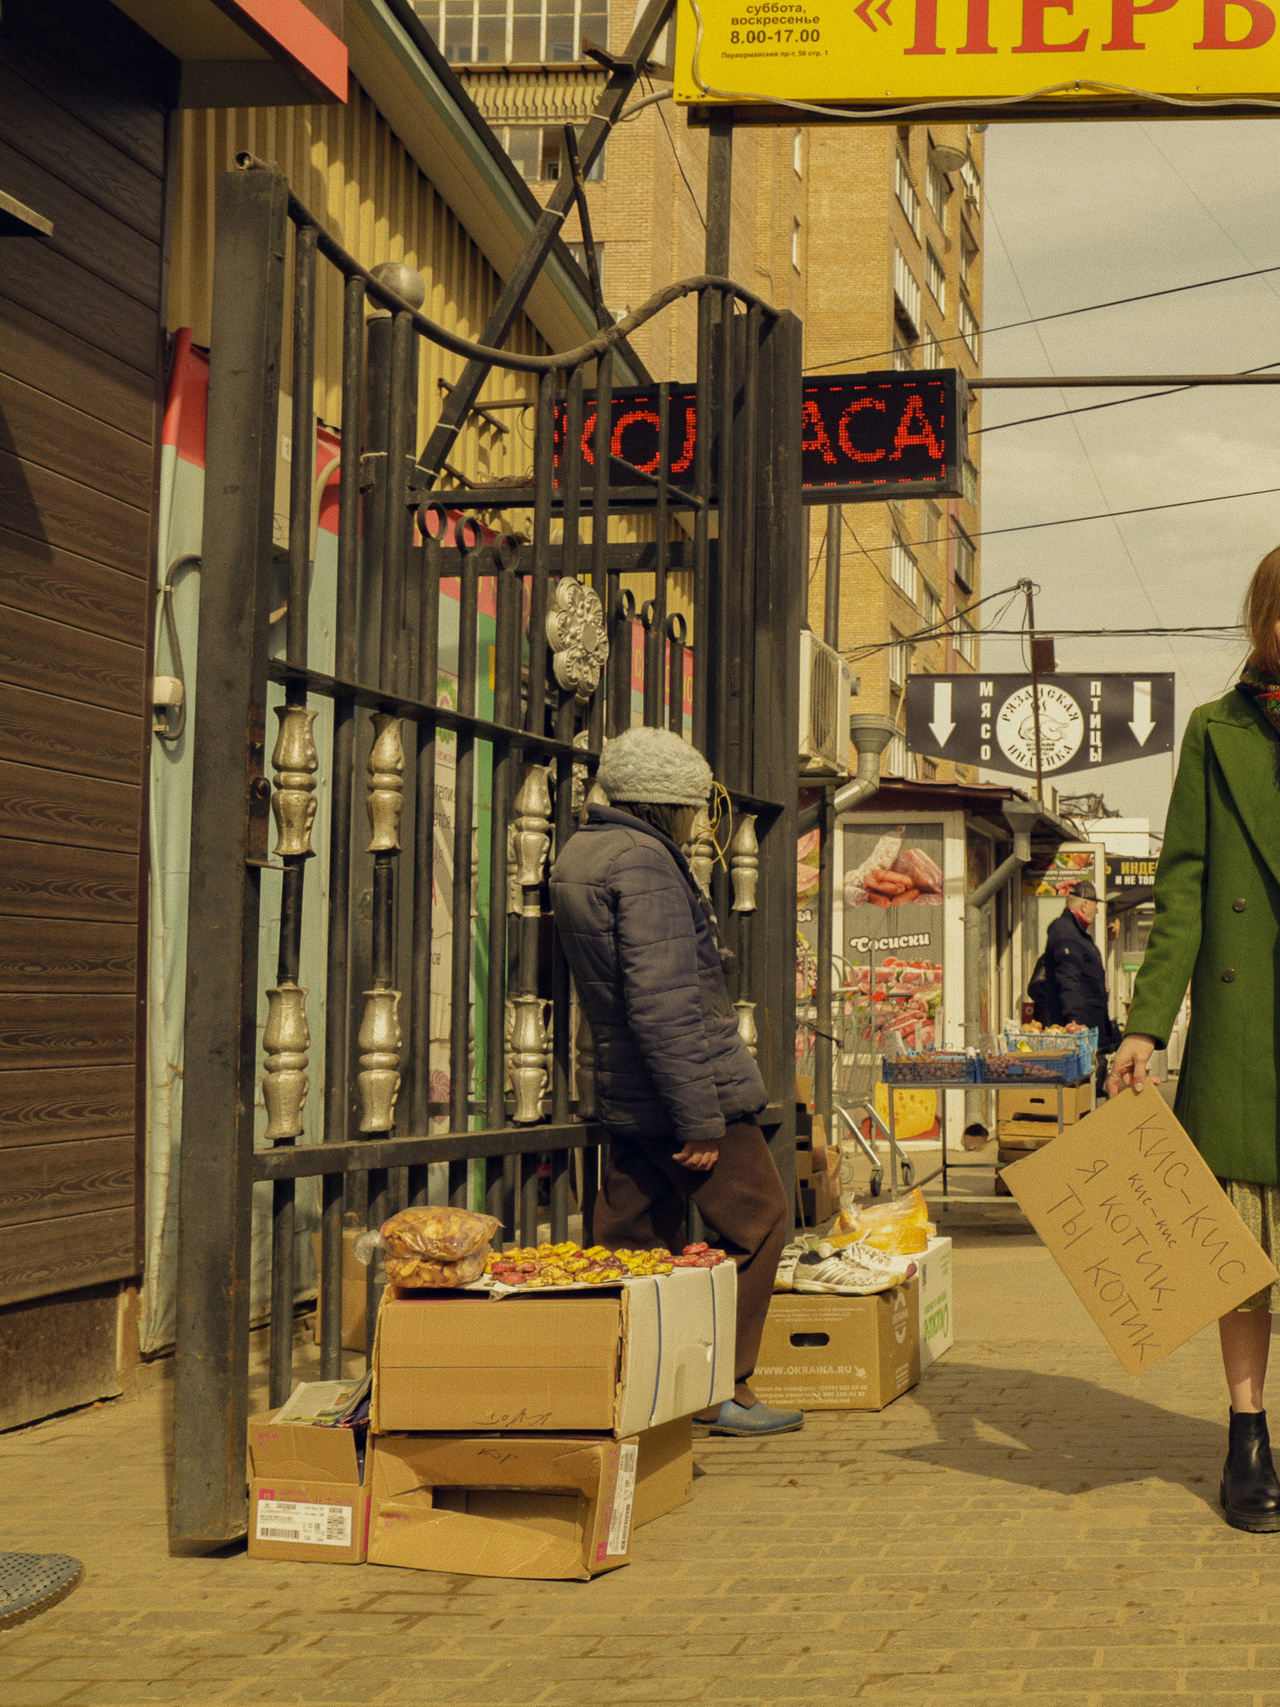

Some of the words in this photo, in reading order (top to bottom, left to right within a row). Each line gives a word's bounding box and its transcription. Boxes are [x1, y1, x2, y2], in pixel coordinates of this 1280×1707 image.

[731, 15, 820, 27] воскресенье
[746, 3, 807, 16] суббота,
[730, 29, 820, 44] 8.00-17.00
[562, 394, 942, 475] КОАСА
[979, 681, 993, 760] МЯСО
[1089, 680, 1102, 762] ПТИЦЫ
[1006, 743, 1074, 768] ИНДЙКА
[1121, 862, 1158, 875] ИНДЕ
[1124, 875, 1136, 885] НЕ
[1138, 875, 1155, 885] ТОЛ
[849, 932, 931, 953] Сосиски
[1075, 1158, 1110, 1184] Я
[1127, 1112, 1246, 1285] КИС-КИС
[1046, 1182, 1093, 1250] ТЫ
[1083, 1257, 1161, 1363] КОТИК
[754, 1365, 852, 1376] WWW.OKRAINA.RU
